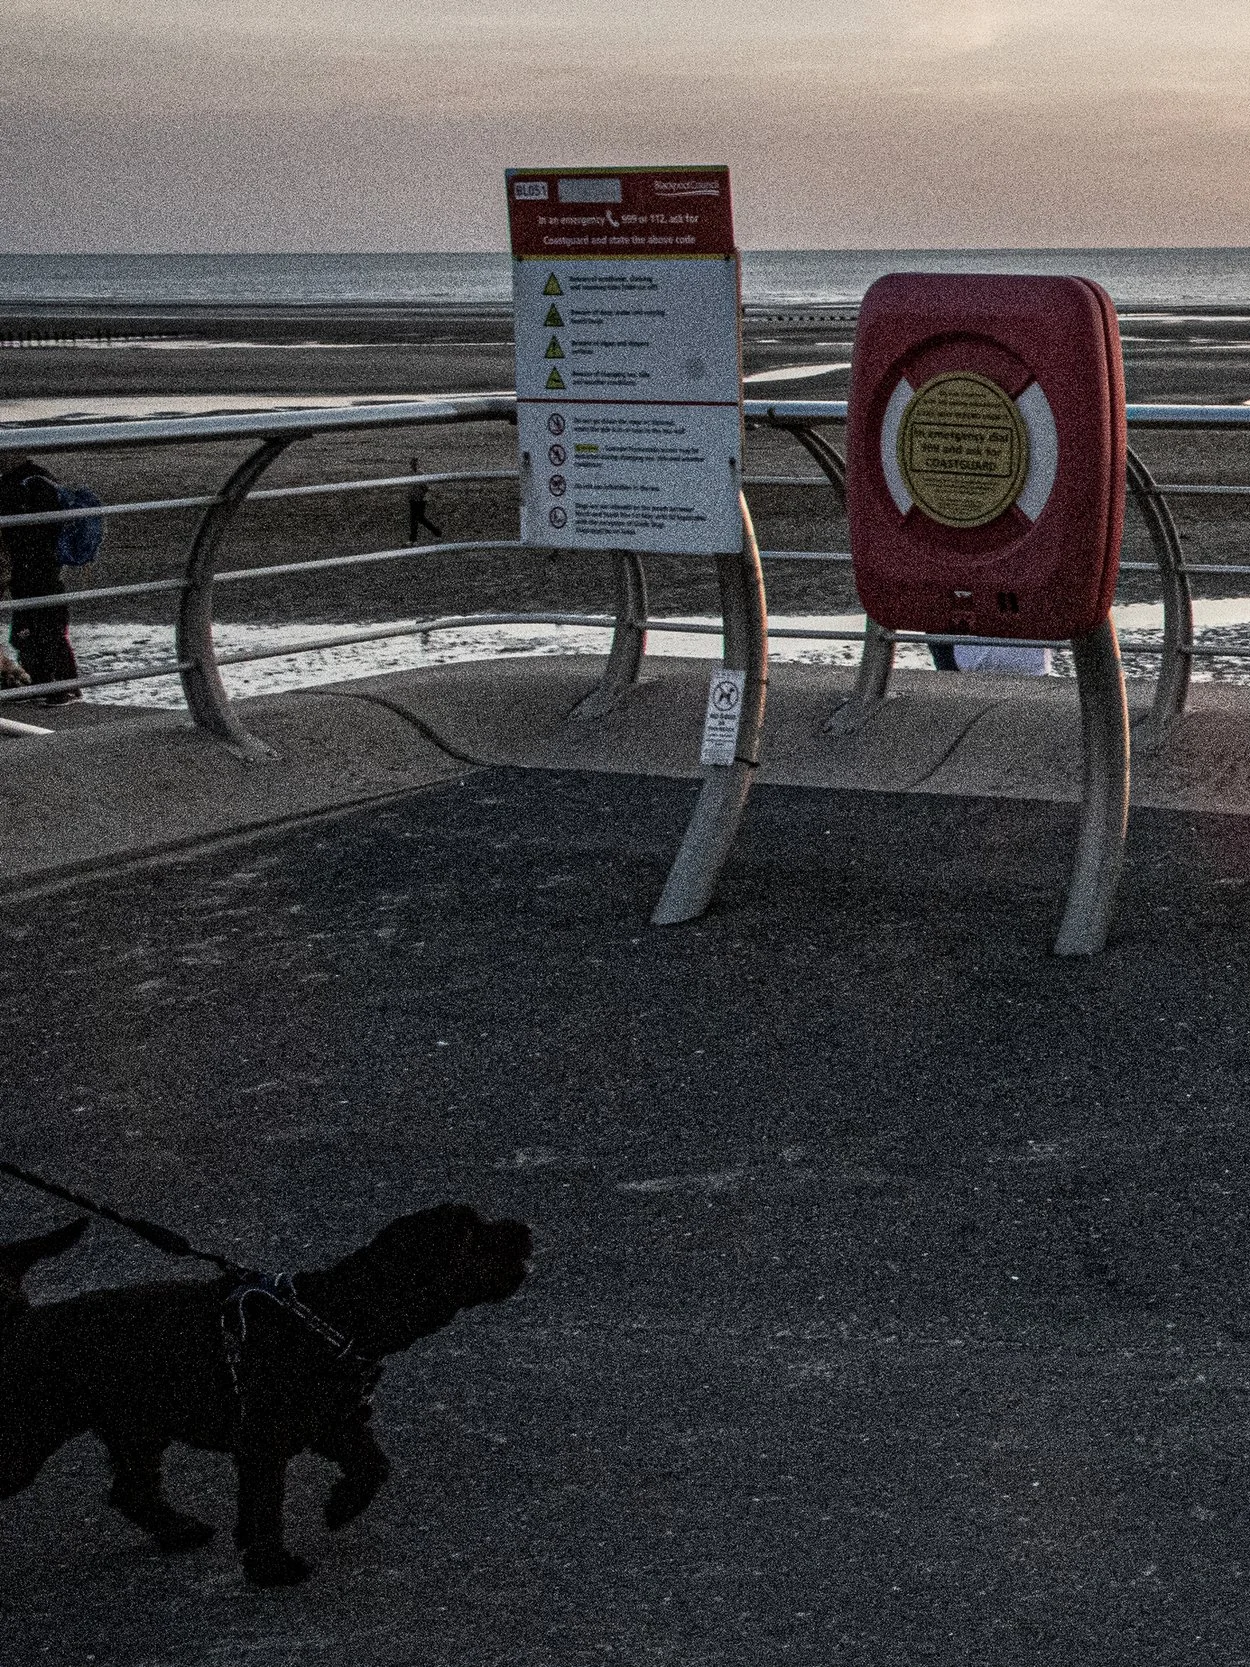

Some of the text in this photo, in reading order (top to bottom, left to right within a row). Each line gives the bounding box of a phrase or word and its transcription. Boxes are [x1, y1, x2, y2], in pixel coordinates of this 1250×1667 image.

[538, 214, 547, 224] In
[548, 216, 559, 225] an
[560, 216, 606, 227] emergency
[621, 213, 637, 224] 999
[638, 214, 648, 224] or
[669, 213, 683, 224] ask
[685, 212, 699, 223] for
[543, 234, 696, 248] Coastguard and state the above code
[928, 431, 985, 444] emergency
[942, 445, 963, 455] and
[985, 446, 1002, 457] for
[925, 458, 997, 472] COASTGUARD
